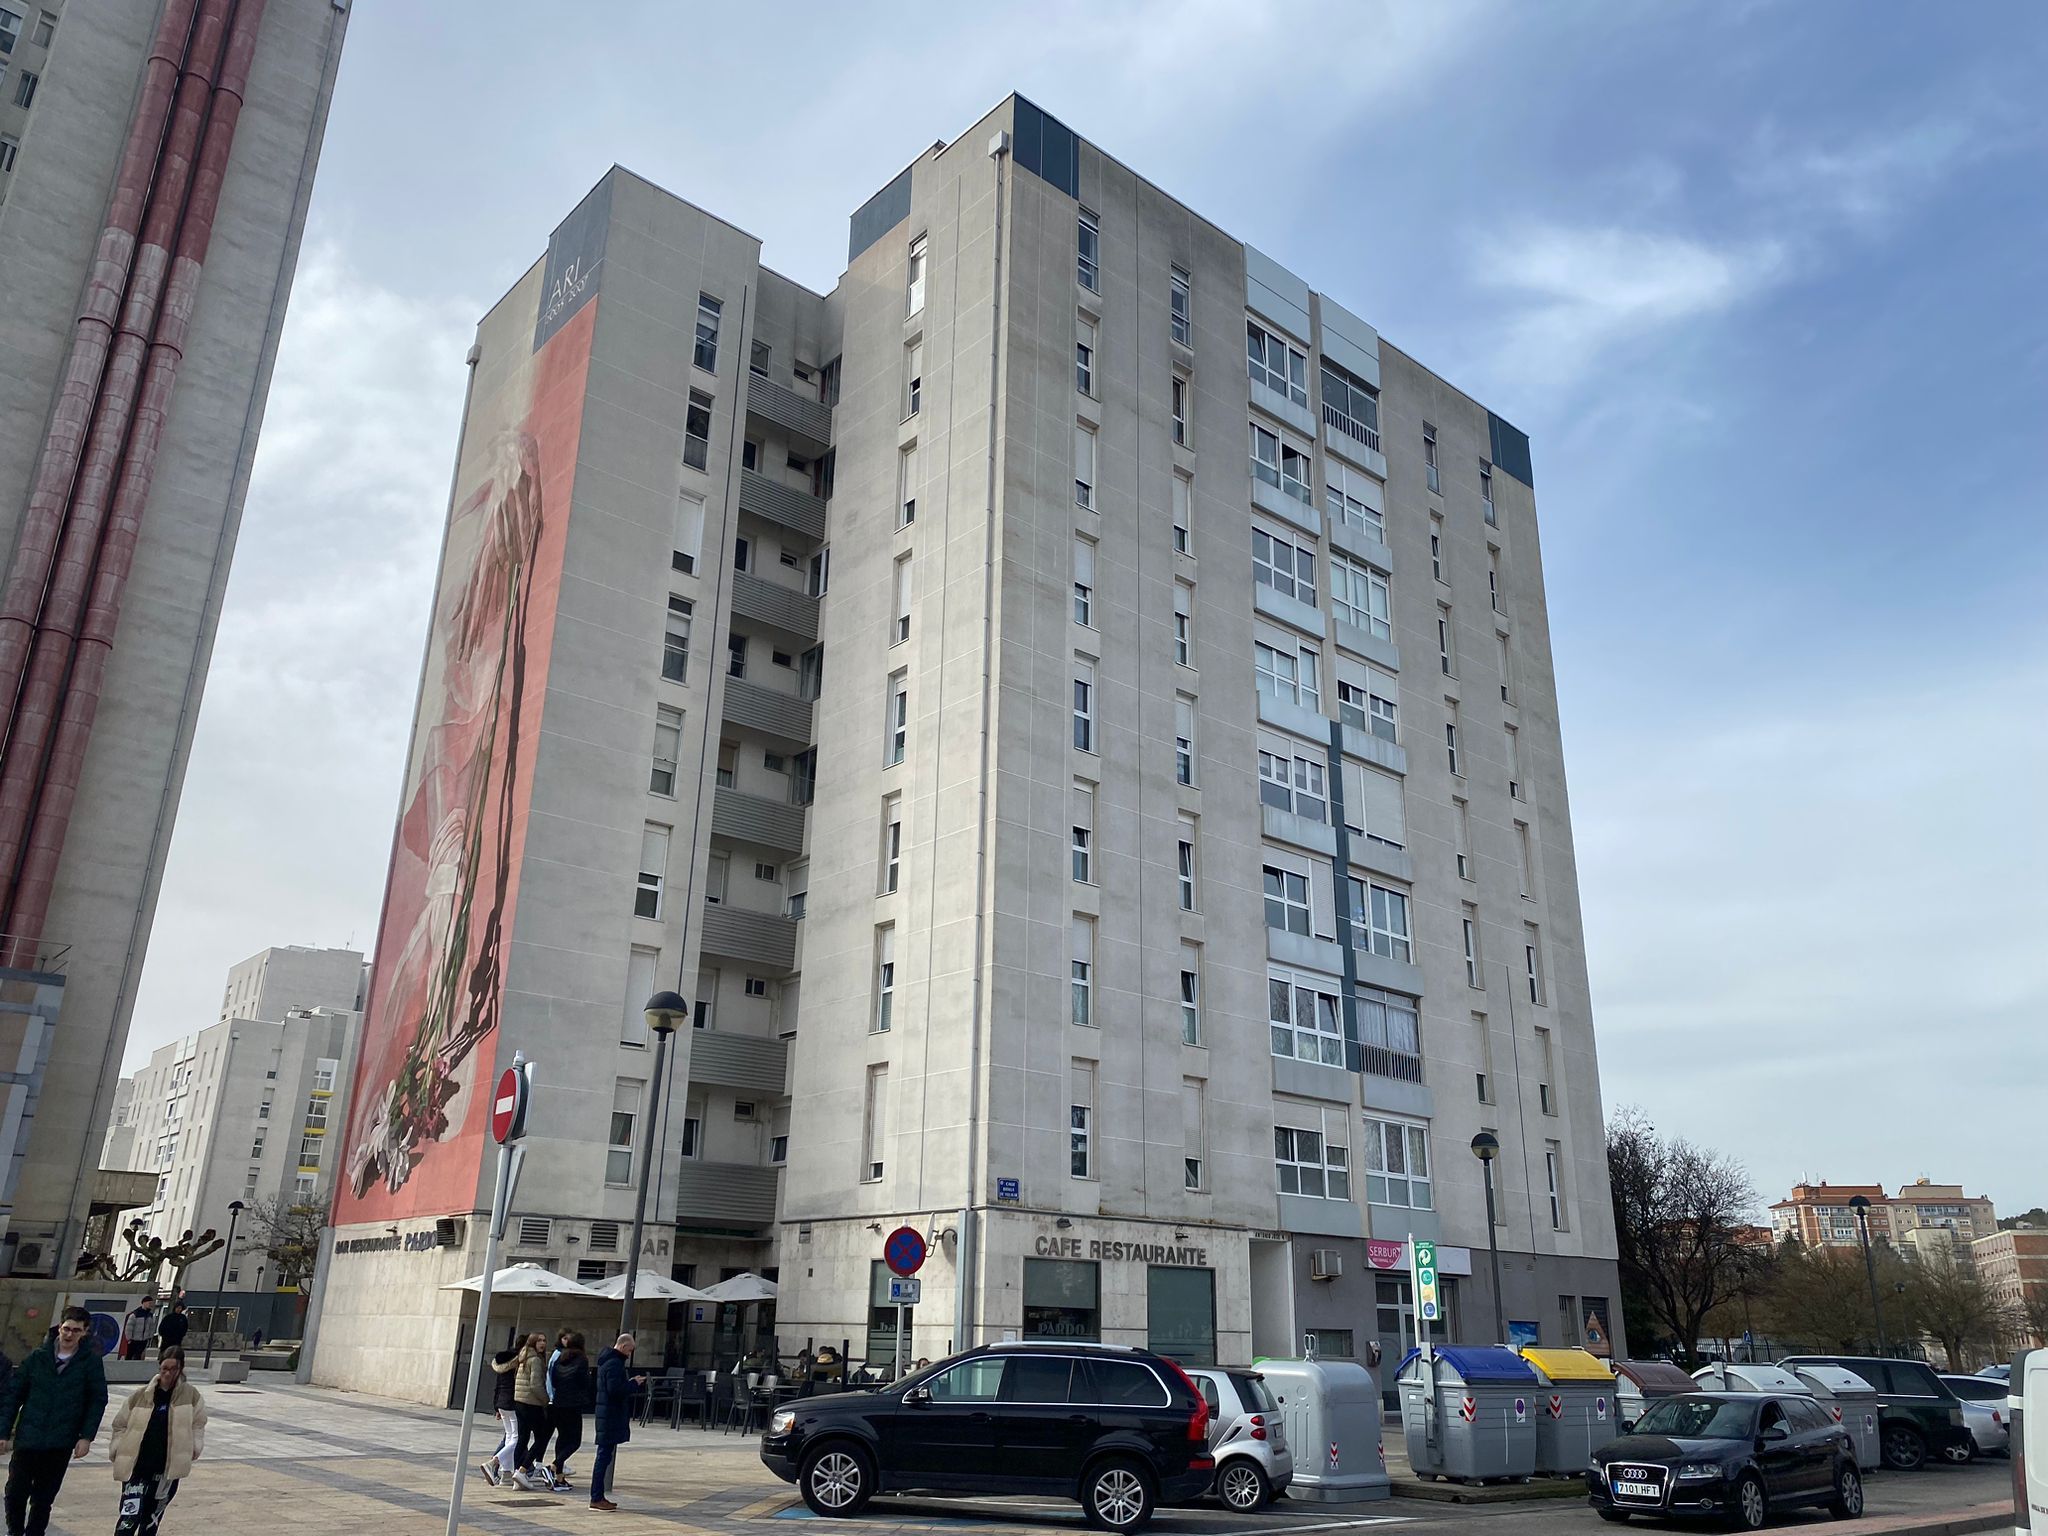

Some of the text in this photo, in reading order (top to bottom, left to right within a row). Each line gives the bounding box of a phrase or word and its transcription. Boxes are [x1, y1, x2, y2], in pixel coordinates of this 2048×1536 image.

[548, 256, 580, 308] ARI
[1035, 1235, 1207, 1266] CAFE RESTAURANTE
[1369, 1246, 1398, 1258] SERBUR
[1619, 1483, 1657, 1495] 7101 HFT
